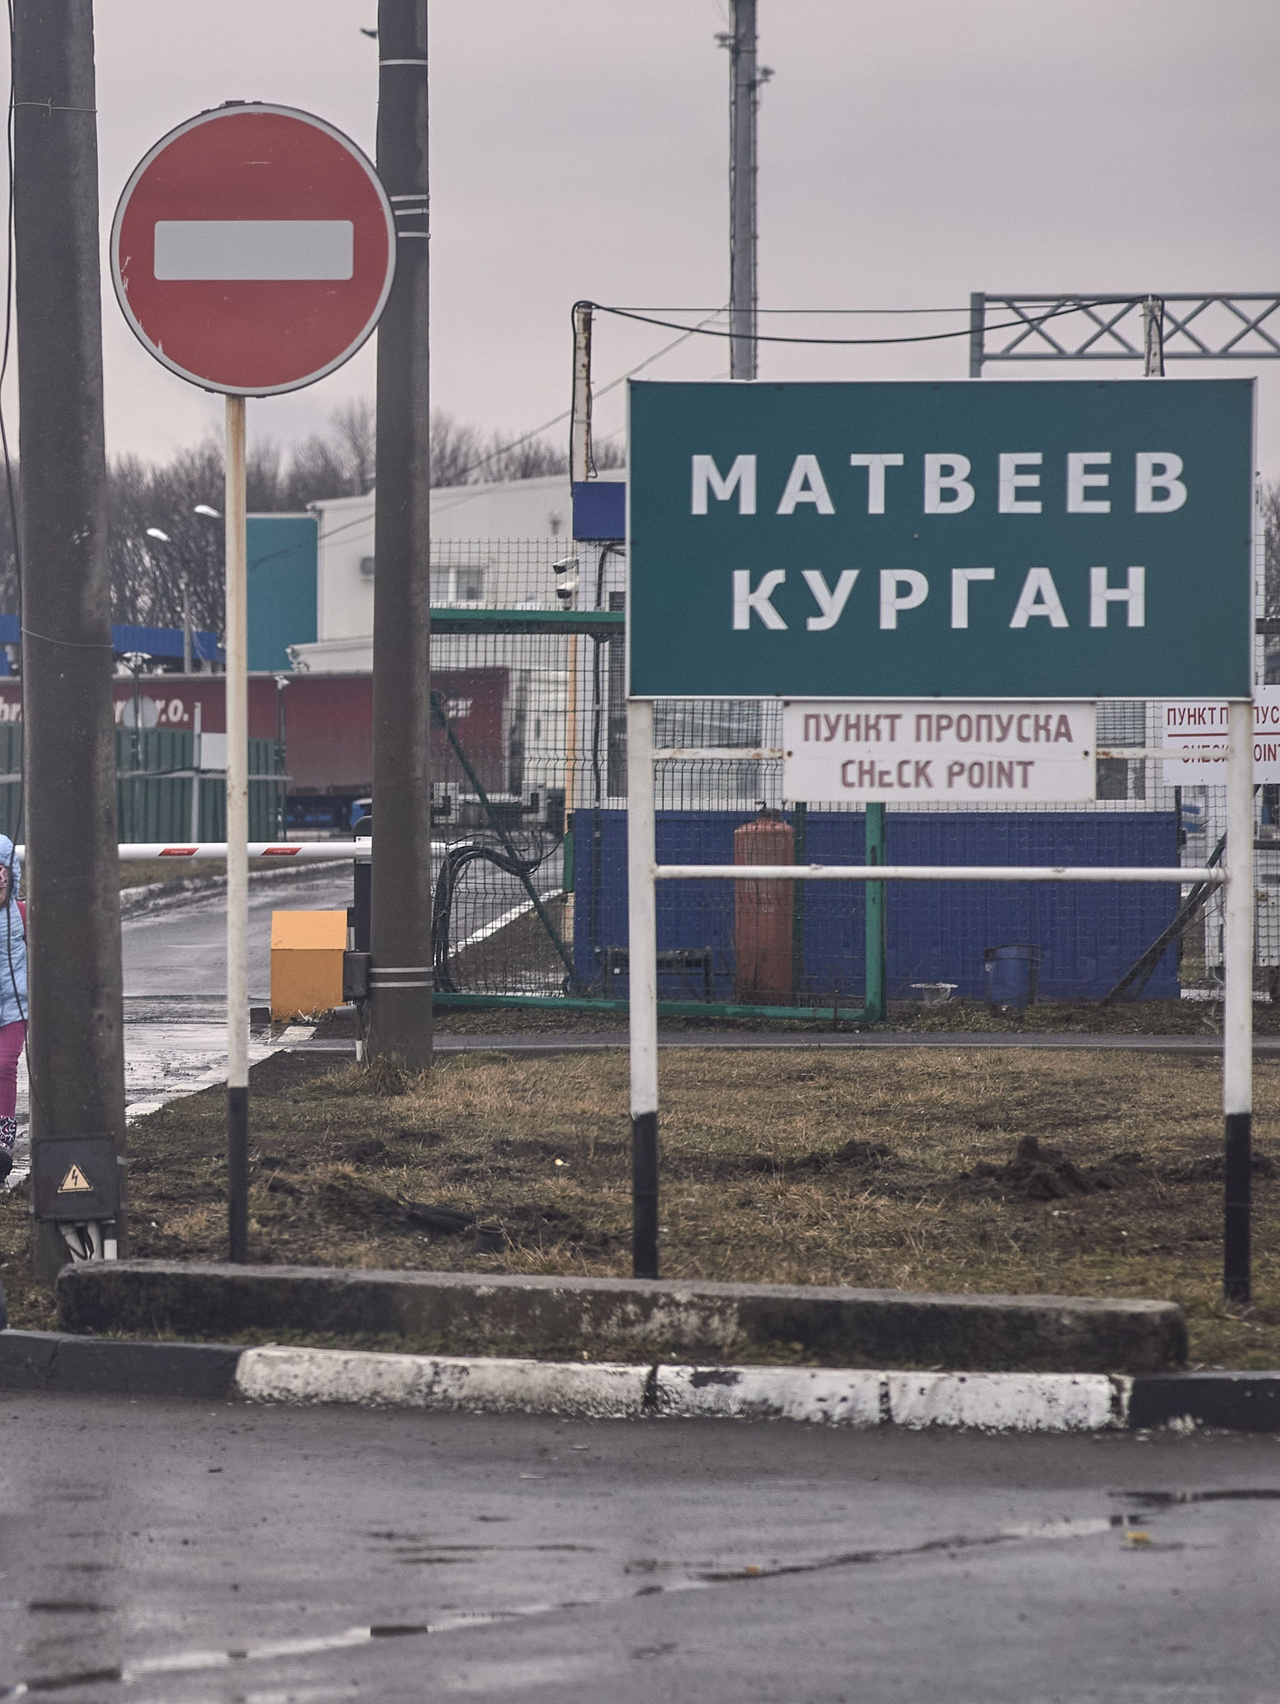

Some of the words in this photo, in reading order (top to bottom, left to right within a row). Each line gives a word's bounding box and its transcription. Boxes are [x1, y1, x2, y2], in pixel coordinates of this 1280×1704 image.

[691, 452, 1188, 515] МАТВЕЕВ
[732, 566, 1146, 631] КУРГАН
[803, 714, 902, 742] ПУНКТ
[915, 714, 1073, 742] ПРОПУСКА
[1167, 707, 1217, 726] ПУНКТ
[947, 760, 1034, 789] POINT
